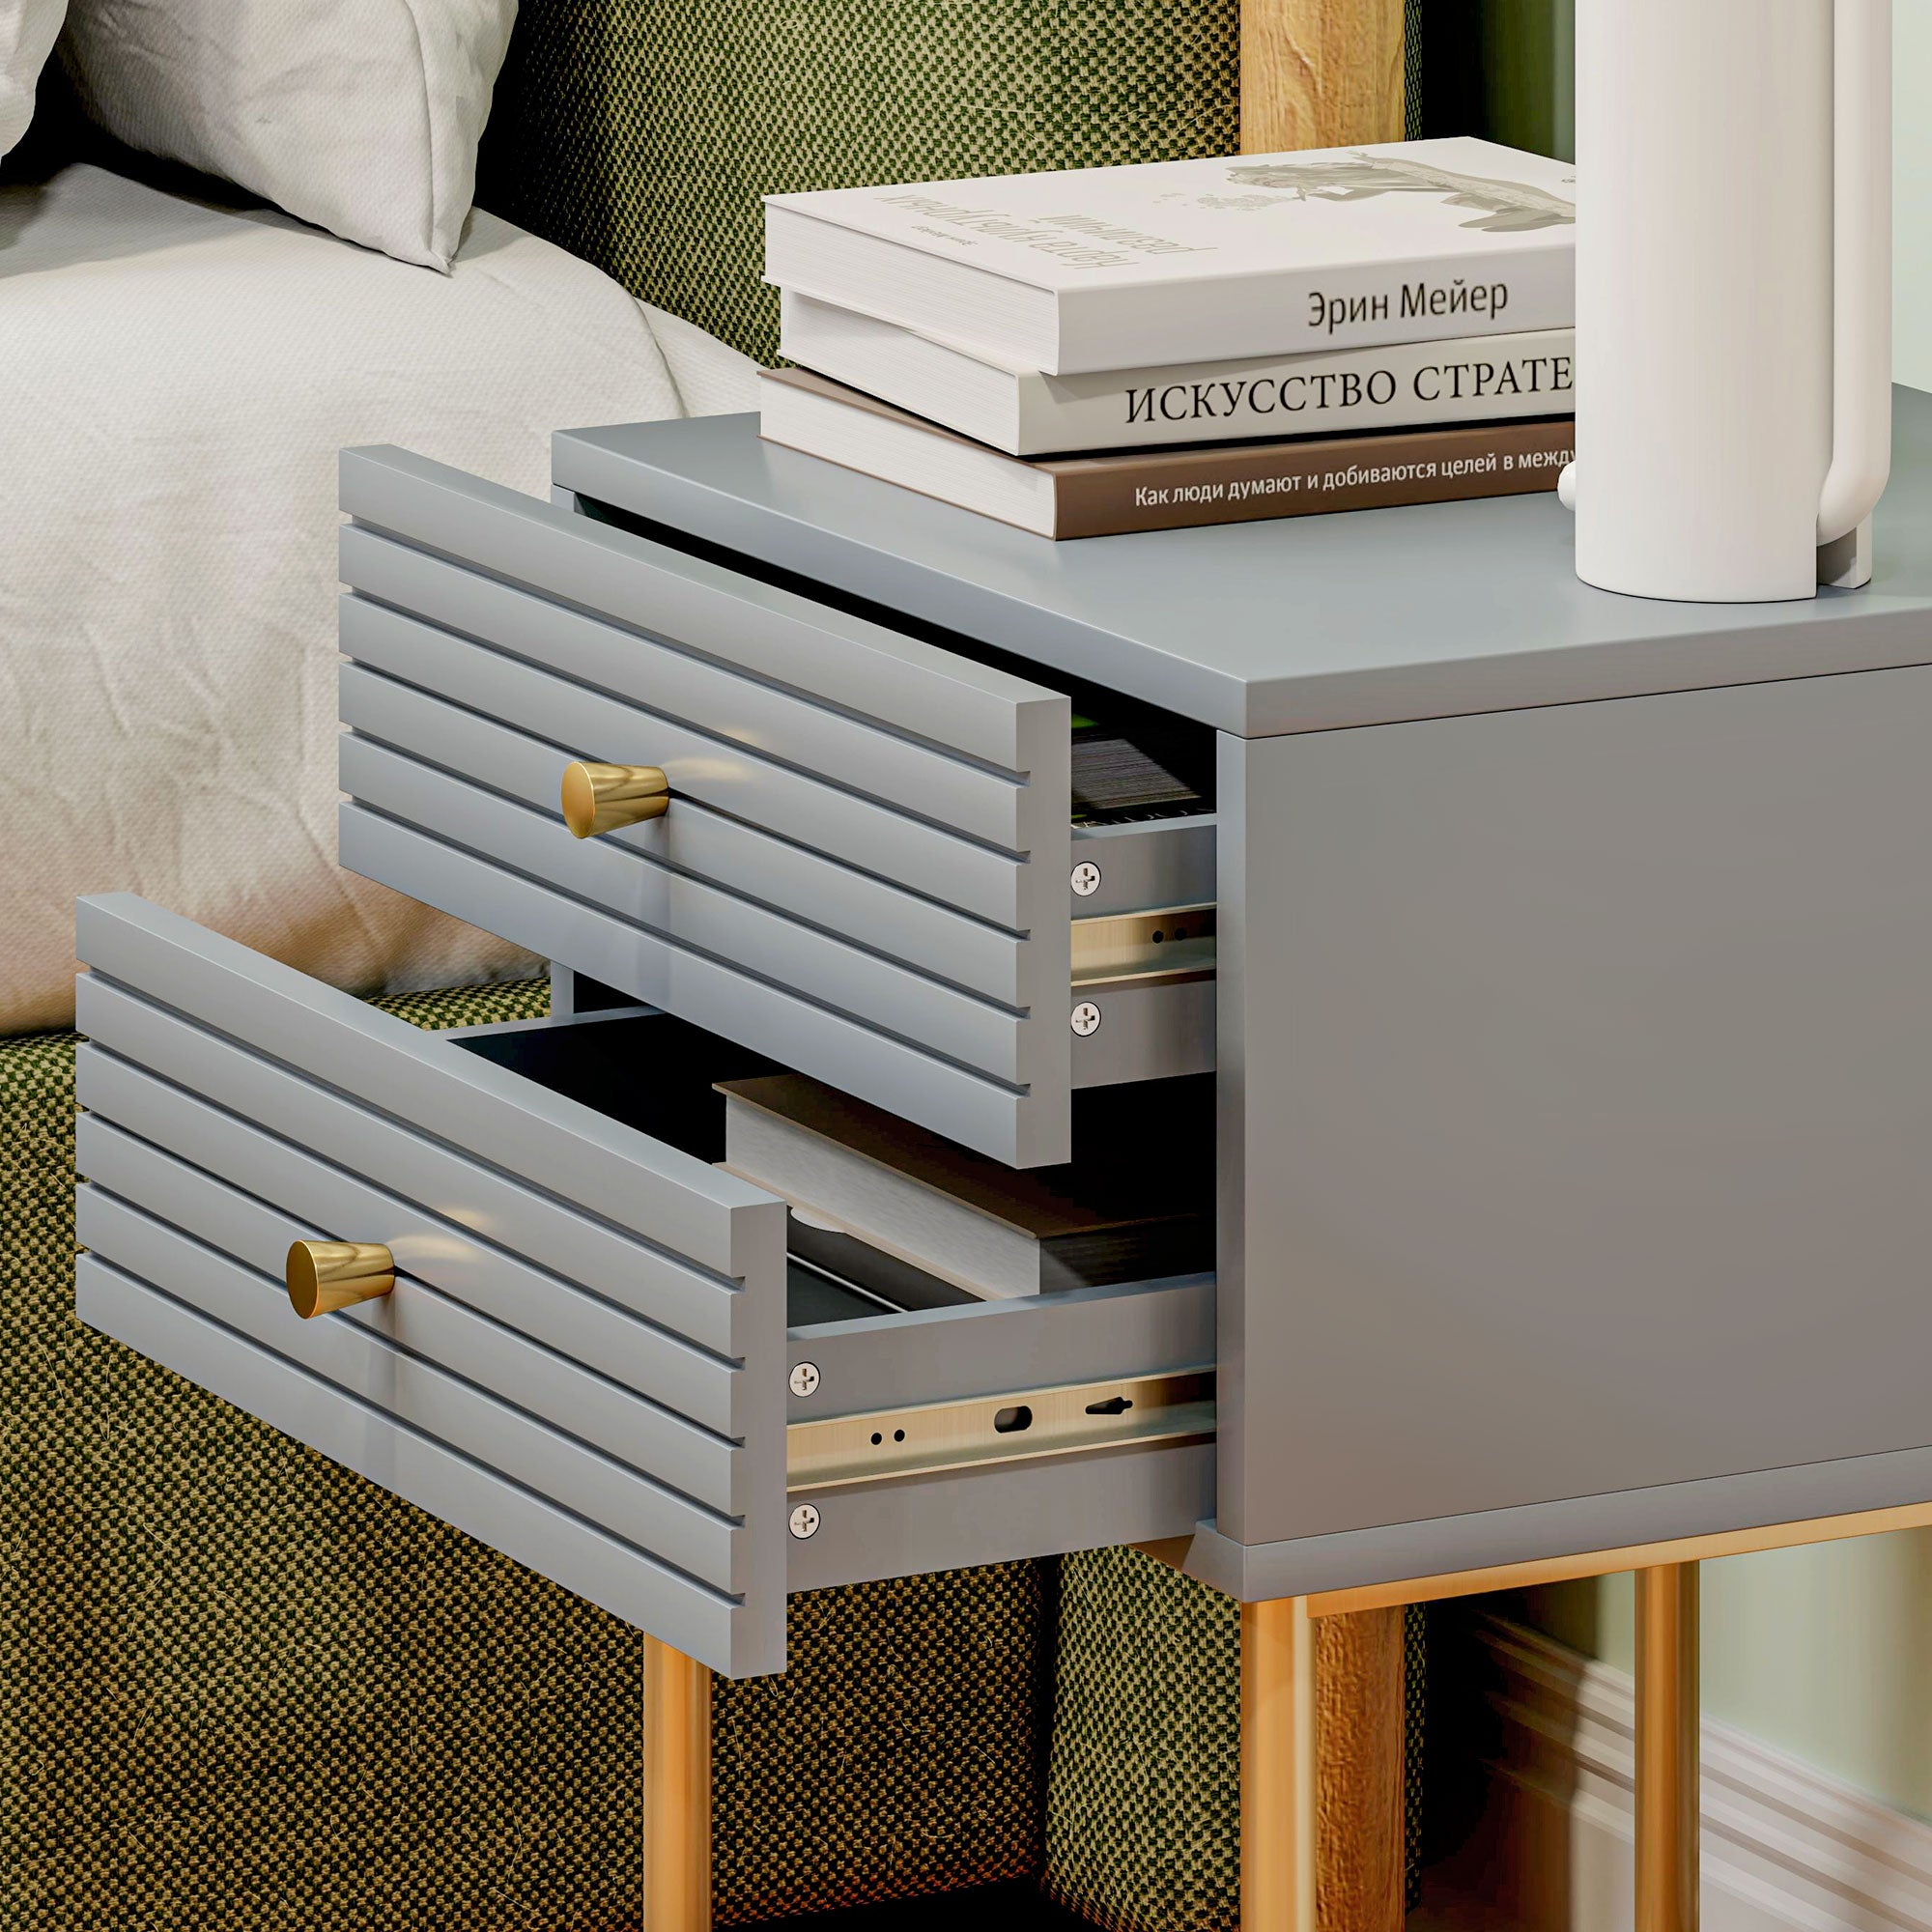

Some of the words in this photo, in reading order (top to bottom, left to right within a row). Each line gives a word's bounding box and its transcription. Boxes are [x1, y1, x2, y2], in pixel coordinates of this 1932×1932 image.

[872, 194, 1065, 243] культурных
[1028, 214, 1219, 255] различий
[1028, 241, 1141, 270] Карта
[1308, 291, 1388, 335] Эрин
[1400, 278, 1508, 321] Мейер
[1125, 369, 1397, 423] ИСКУССТВО
[1412, 356, 1573, 401] СТРАТЕ
[1135, 486, 1170, 507] Как
[1172, 483, 1224, 503] люди
[1227, 475, 1302, 500] думают
[1307, 473, 1319, 490] и
[1321, 461, 1437, 492] добиваются
[1441, 452, 1497, 479] целей
[1503, 454, 1514, 470] в
